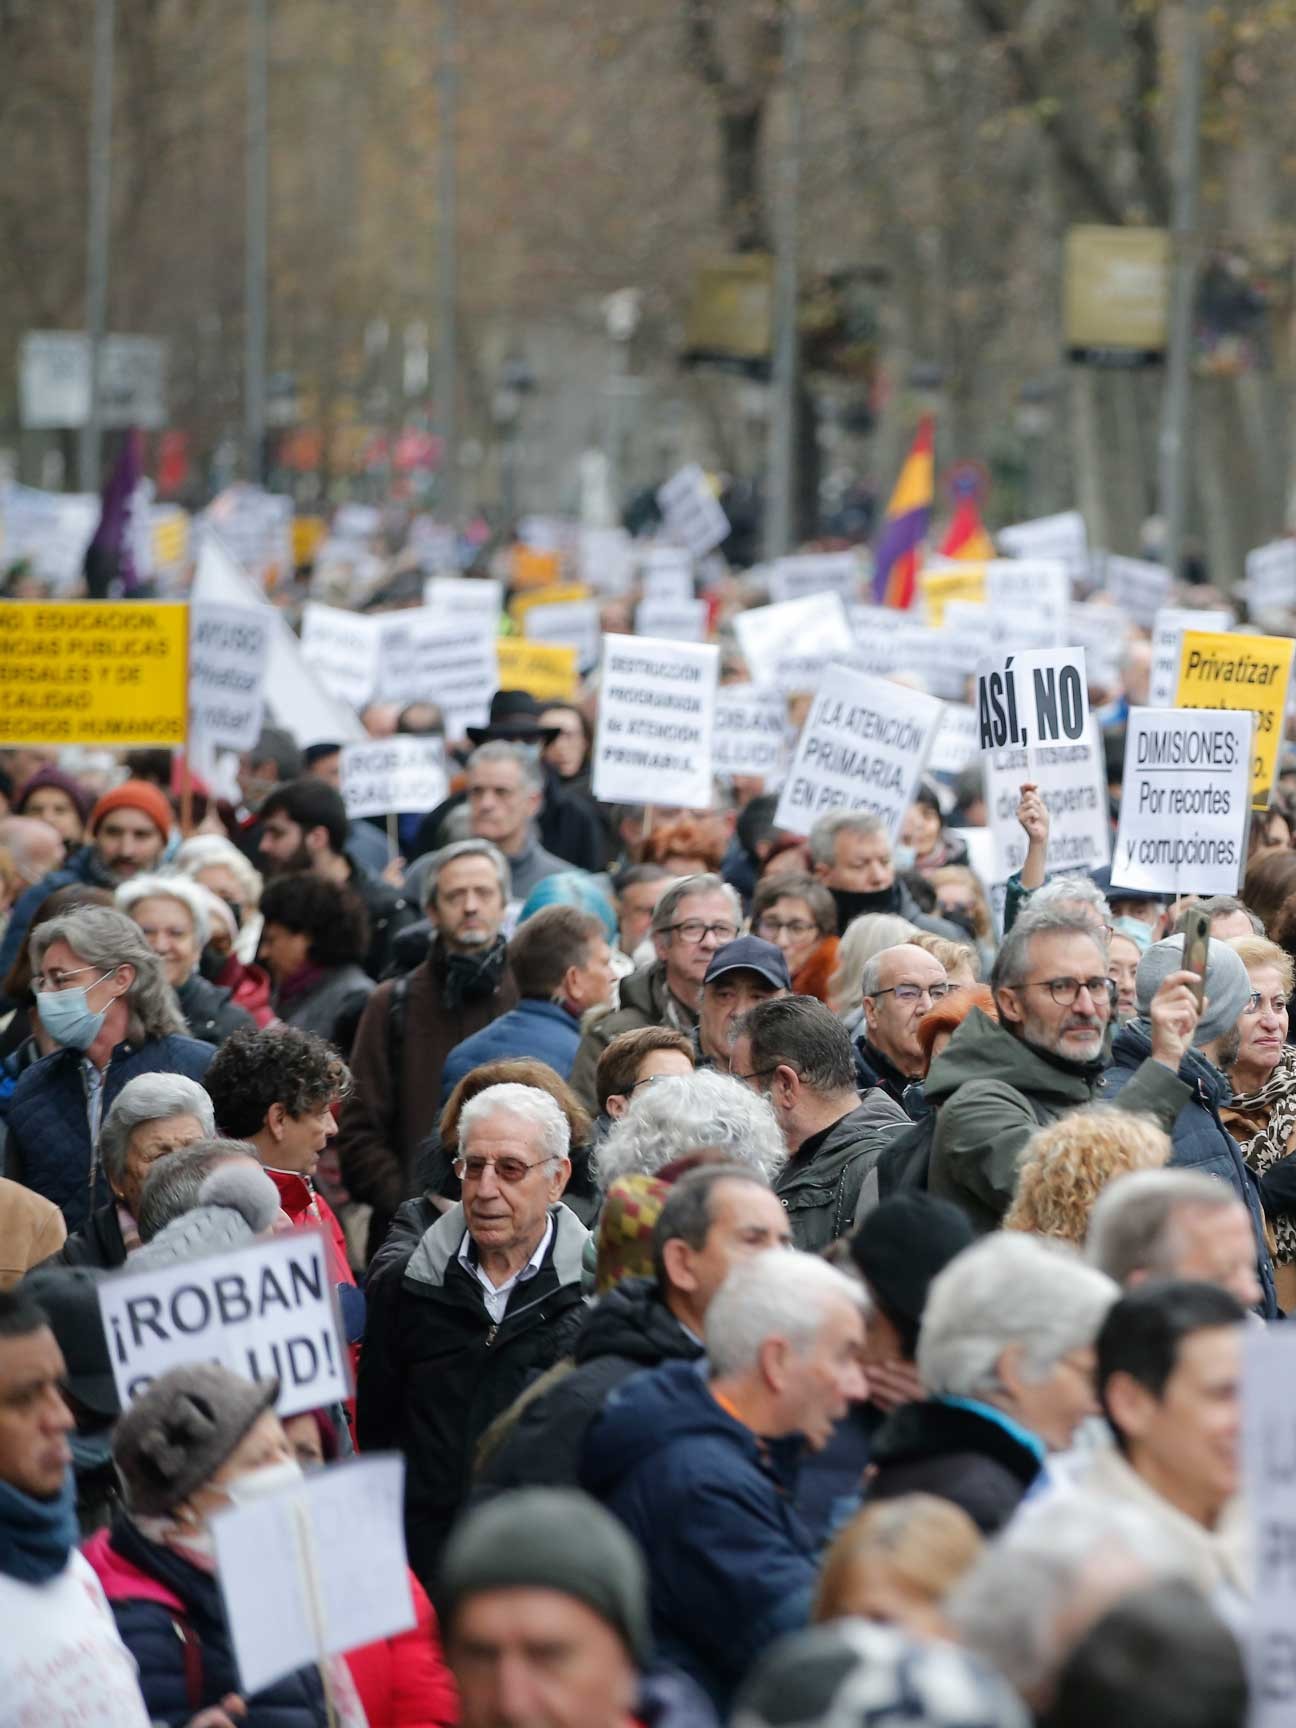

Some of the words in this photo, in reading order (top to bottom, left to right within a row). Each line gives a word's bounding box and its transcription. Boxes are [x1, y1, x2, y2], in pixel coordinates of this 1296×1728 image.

[1185, 651, 1280, 686] Privatizar
[979, 656, 1027, 750] ASÍ,
[1033, 665, 1084, 740] NO
[846, 705, 928, 754] ATENCIÓN
[1137, 731, 1240, 765] DIMISIONES:
[790, 777, 815, 809] EN
[1139, 781, 1165, 815] Por
[1168, 781, 1231, 815] recortes
[1125, 838, 1137, 872] y
[1139, 831, 1239, 872] corrupciones.
[110, 1255, 324, 1365] ¡ROBAN
